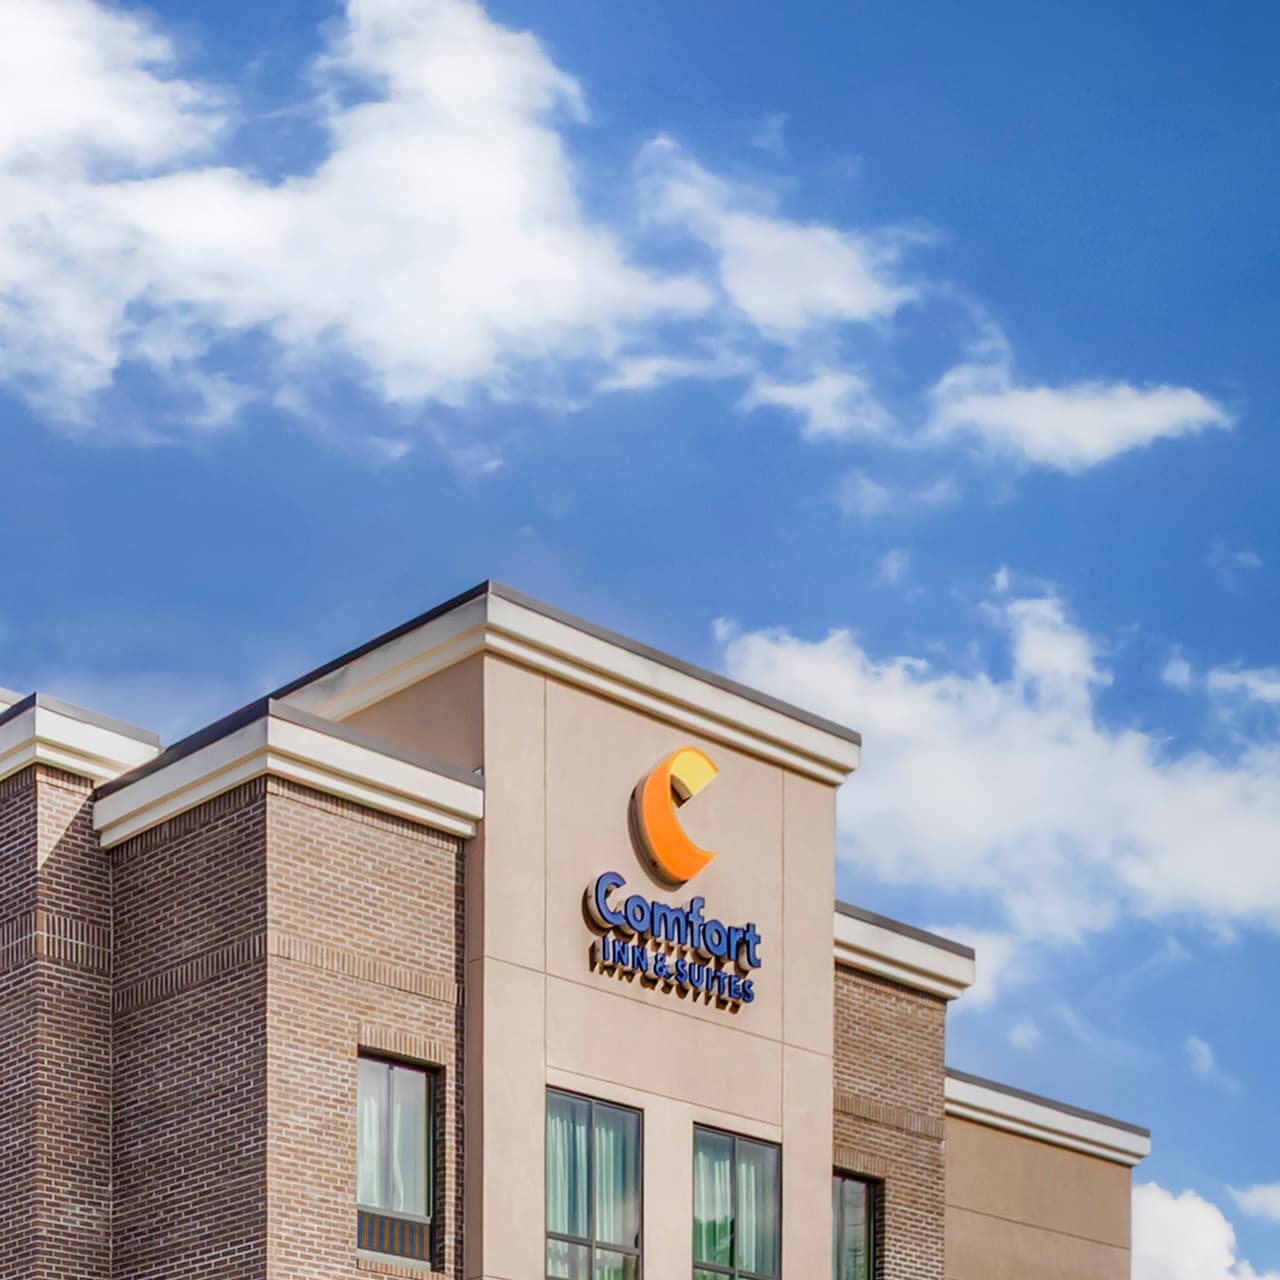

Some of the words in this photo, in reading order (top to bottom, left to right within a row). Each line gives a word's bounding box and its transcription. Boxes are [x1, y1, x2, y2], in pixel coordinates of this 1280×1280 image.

[594, 871, 762, 969] Comfort
[602, 935, 649, 972] INN
[653, 953, 670, 980] &
[675, 958, 755, 1004] SUITES
